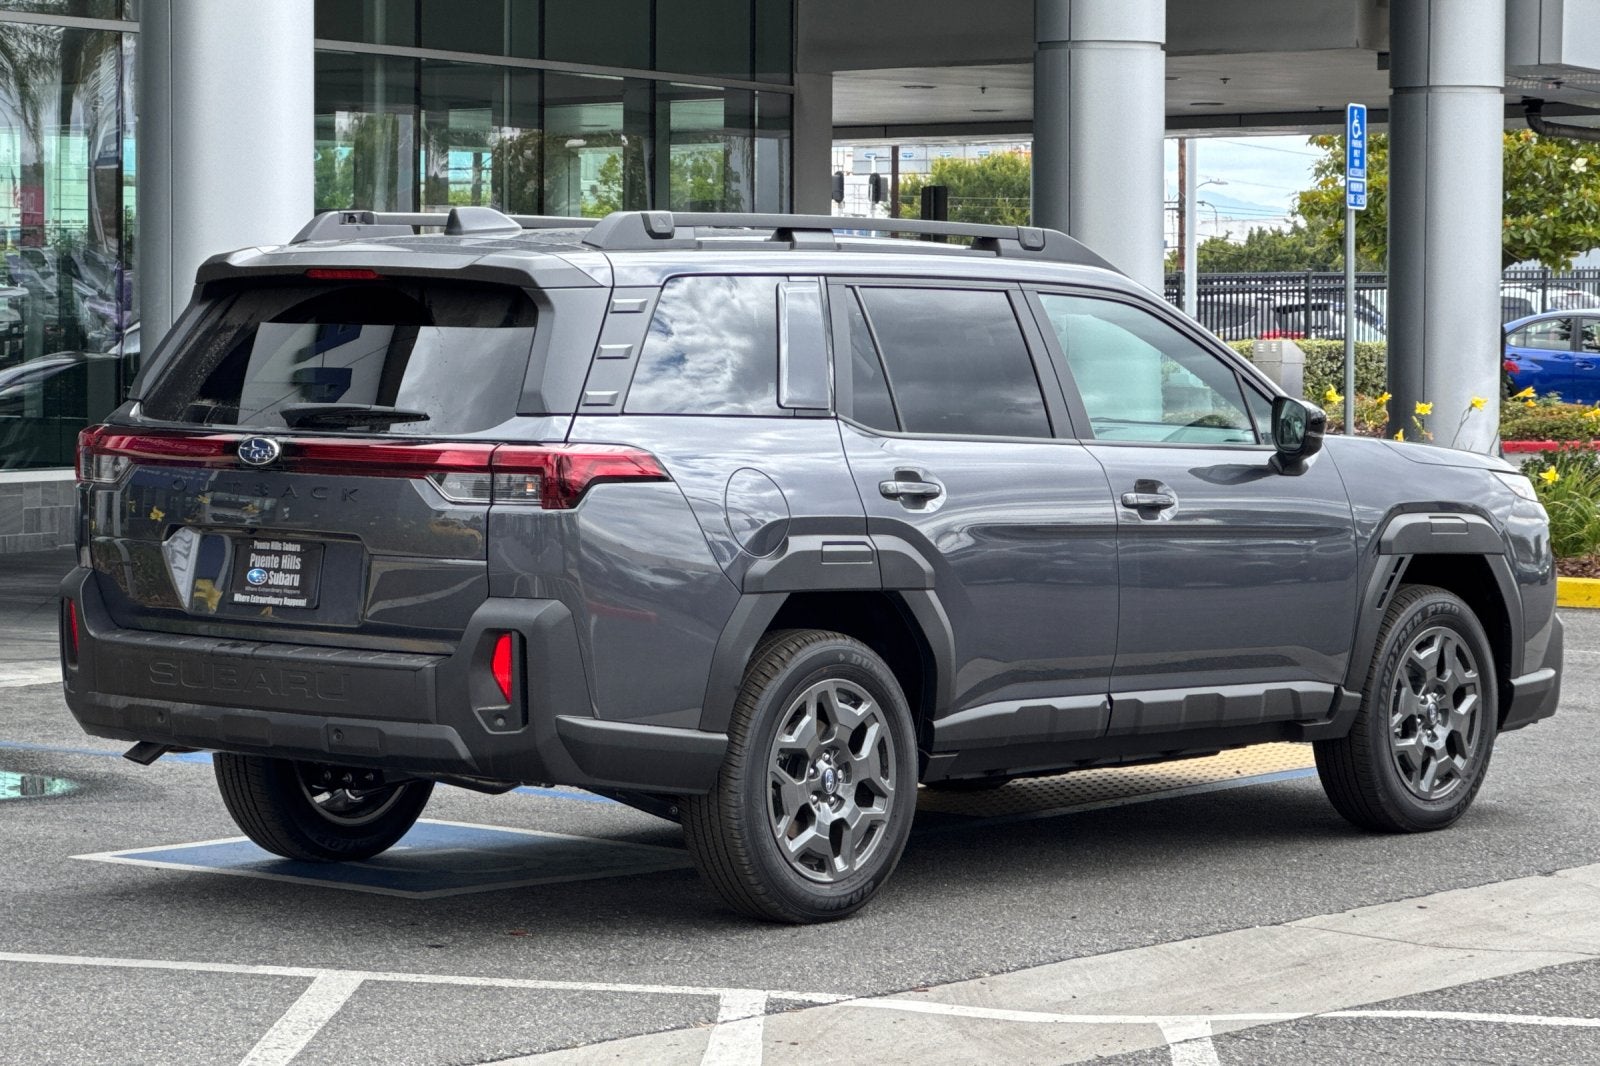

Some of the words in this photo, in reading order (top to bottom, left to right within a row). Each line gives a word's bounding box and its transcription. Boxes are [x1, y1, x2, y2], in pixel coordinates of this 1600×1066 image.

[172, 478, 359, 502] OUTBACK
[249, 553, 280, 569] Puente
[281, 554, 302, 570] Hills
[268, 570, 300, 586] Subaru
[1427, 602, 1460, 617] PT20
[149, 660, 350, 700] SUBARU
